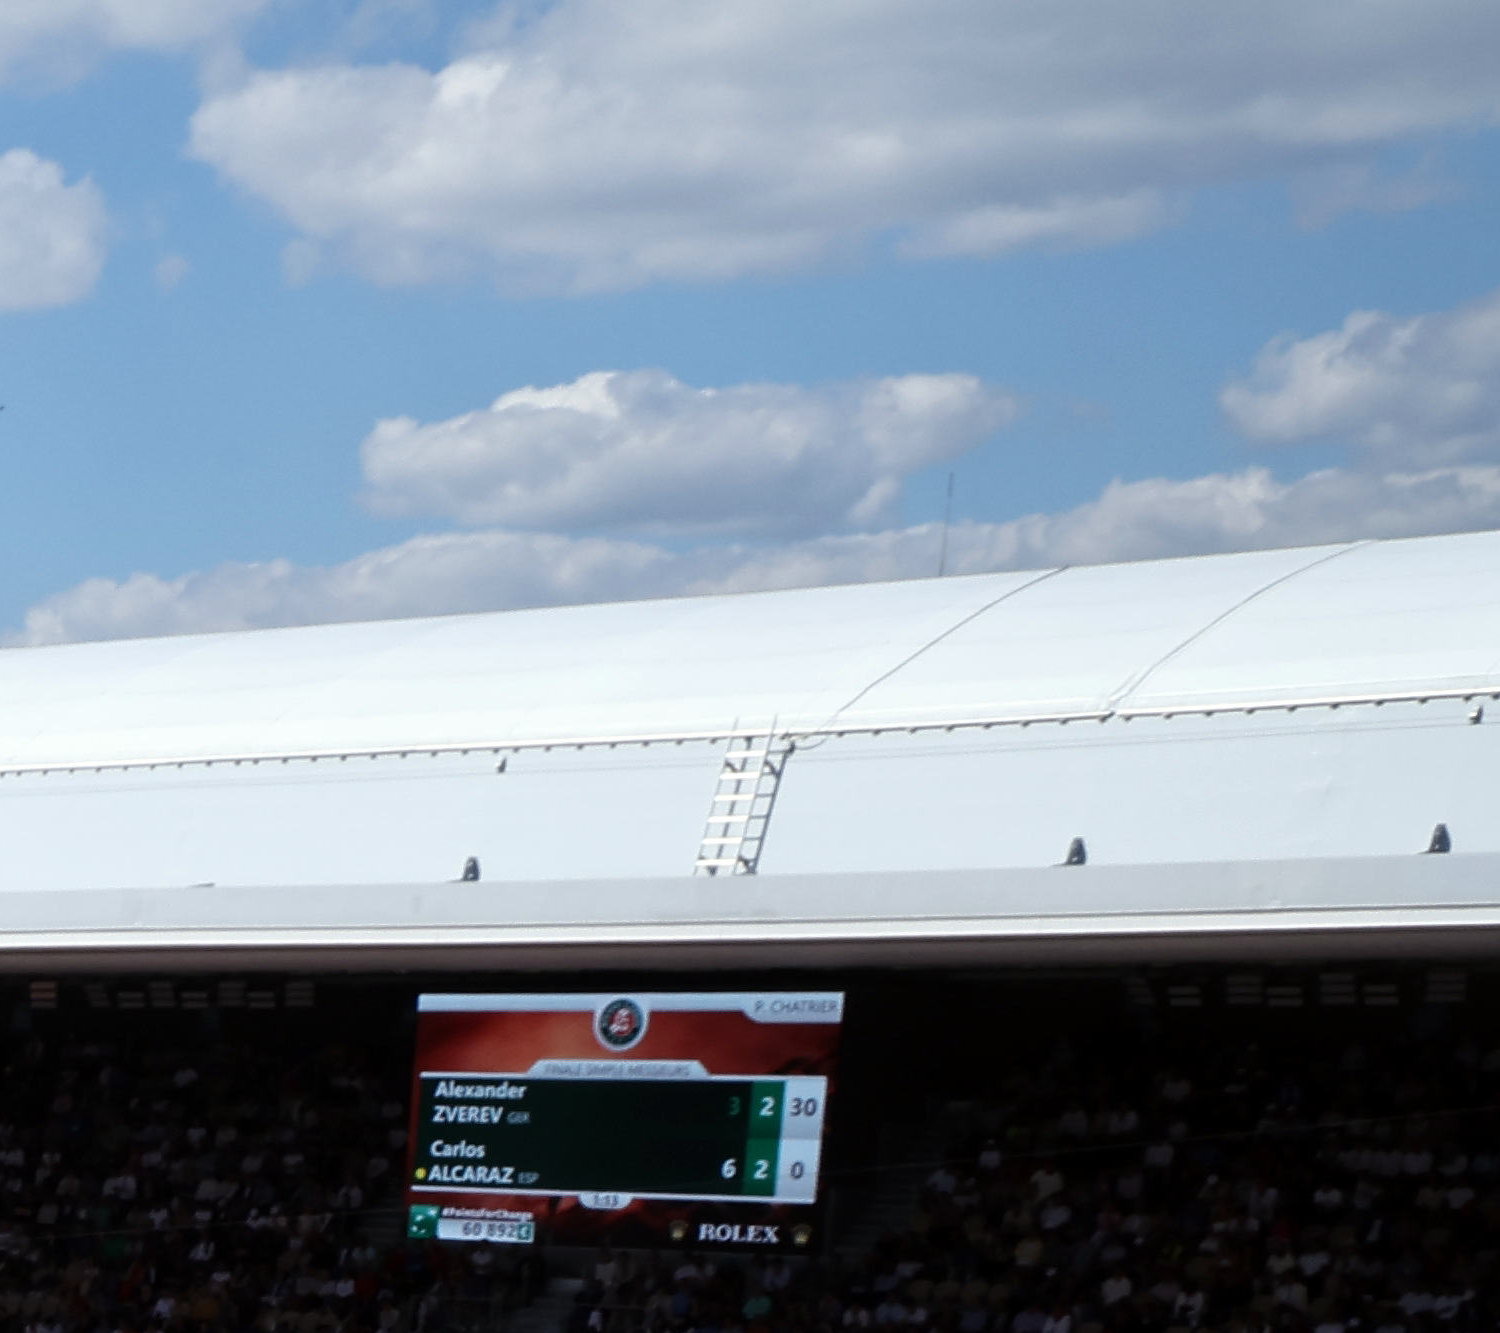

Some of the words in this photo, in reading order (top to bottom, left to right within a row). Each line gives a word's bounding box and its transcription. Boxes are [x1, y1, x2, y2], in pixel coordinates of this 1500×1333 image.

[435, 1080, 527, 1100] Alexander
[432, 1105, 504, 1125] ZVEREV
[729, 1097, 741, 1115] 3
[760, 1097, 775, 1116] 2
[790, 1098, 817, 1117] 30
[430, 1140, 486, 1159] Carlos
[428, 1165, 515, 1184] ALCARAZ
[721, 1159, 737, 1179] 6
[754, 1160, 769, 1180] 2
[790, 1161, 804, 1180] 0
[699, 1223, 780, 1244] ROLEX
